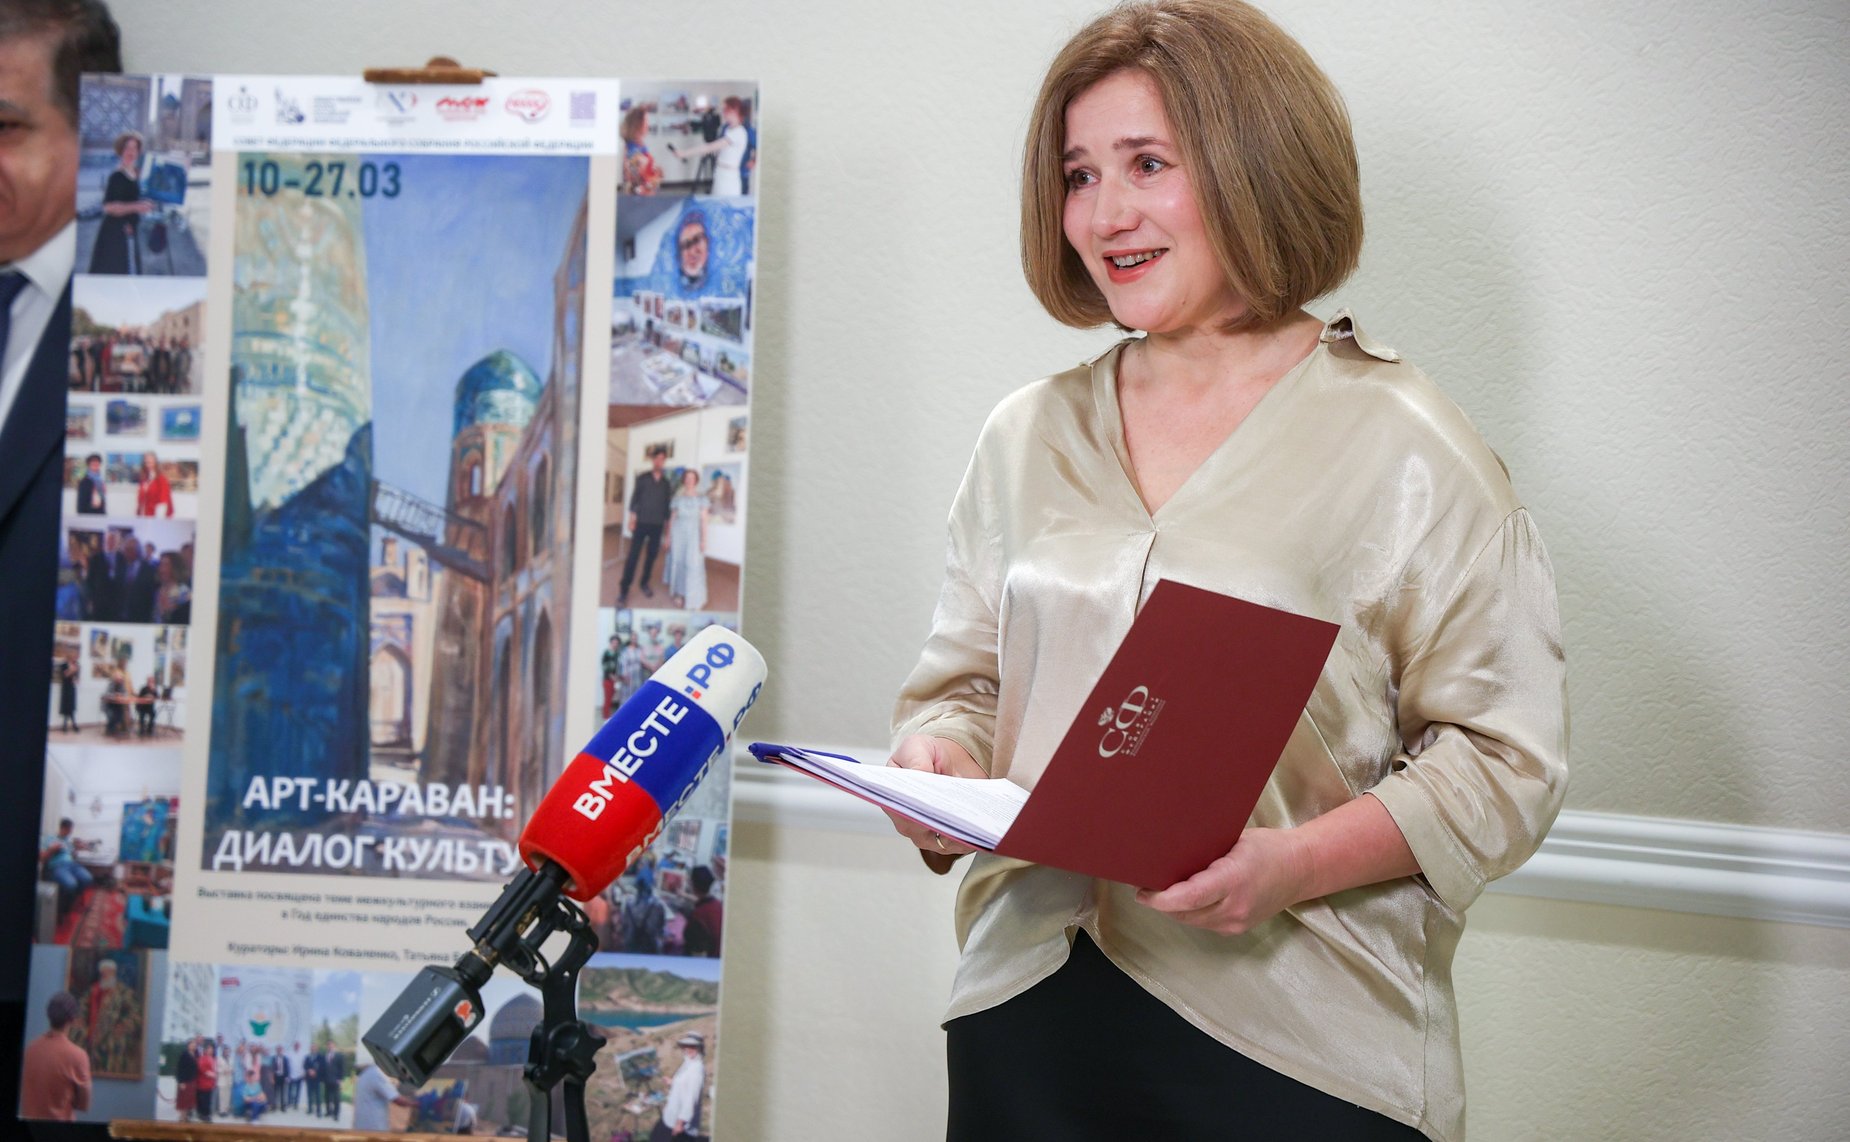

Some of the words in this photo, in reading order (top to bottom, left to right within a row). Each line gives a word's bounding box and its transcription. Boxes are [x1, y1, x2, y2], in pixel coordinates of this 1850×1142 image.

[243, 775, 515, 819] АРТ-КАРАВАН:
[212, 829, 376, 872] ДИАЛОГ
[383, 836, 519, 876] КУЛЬТУ
